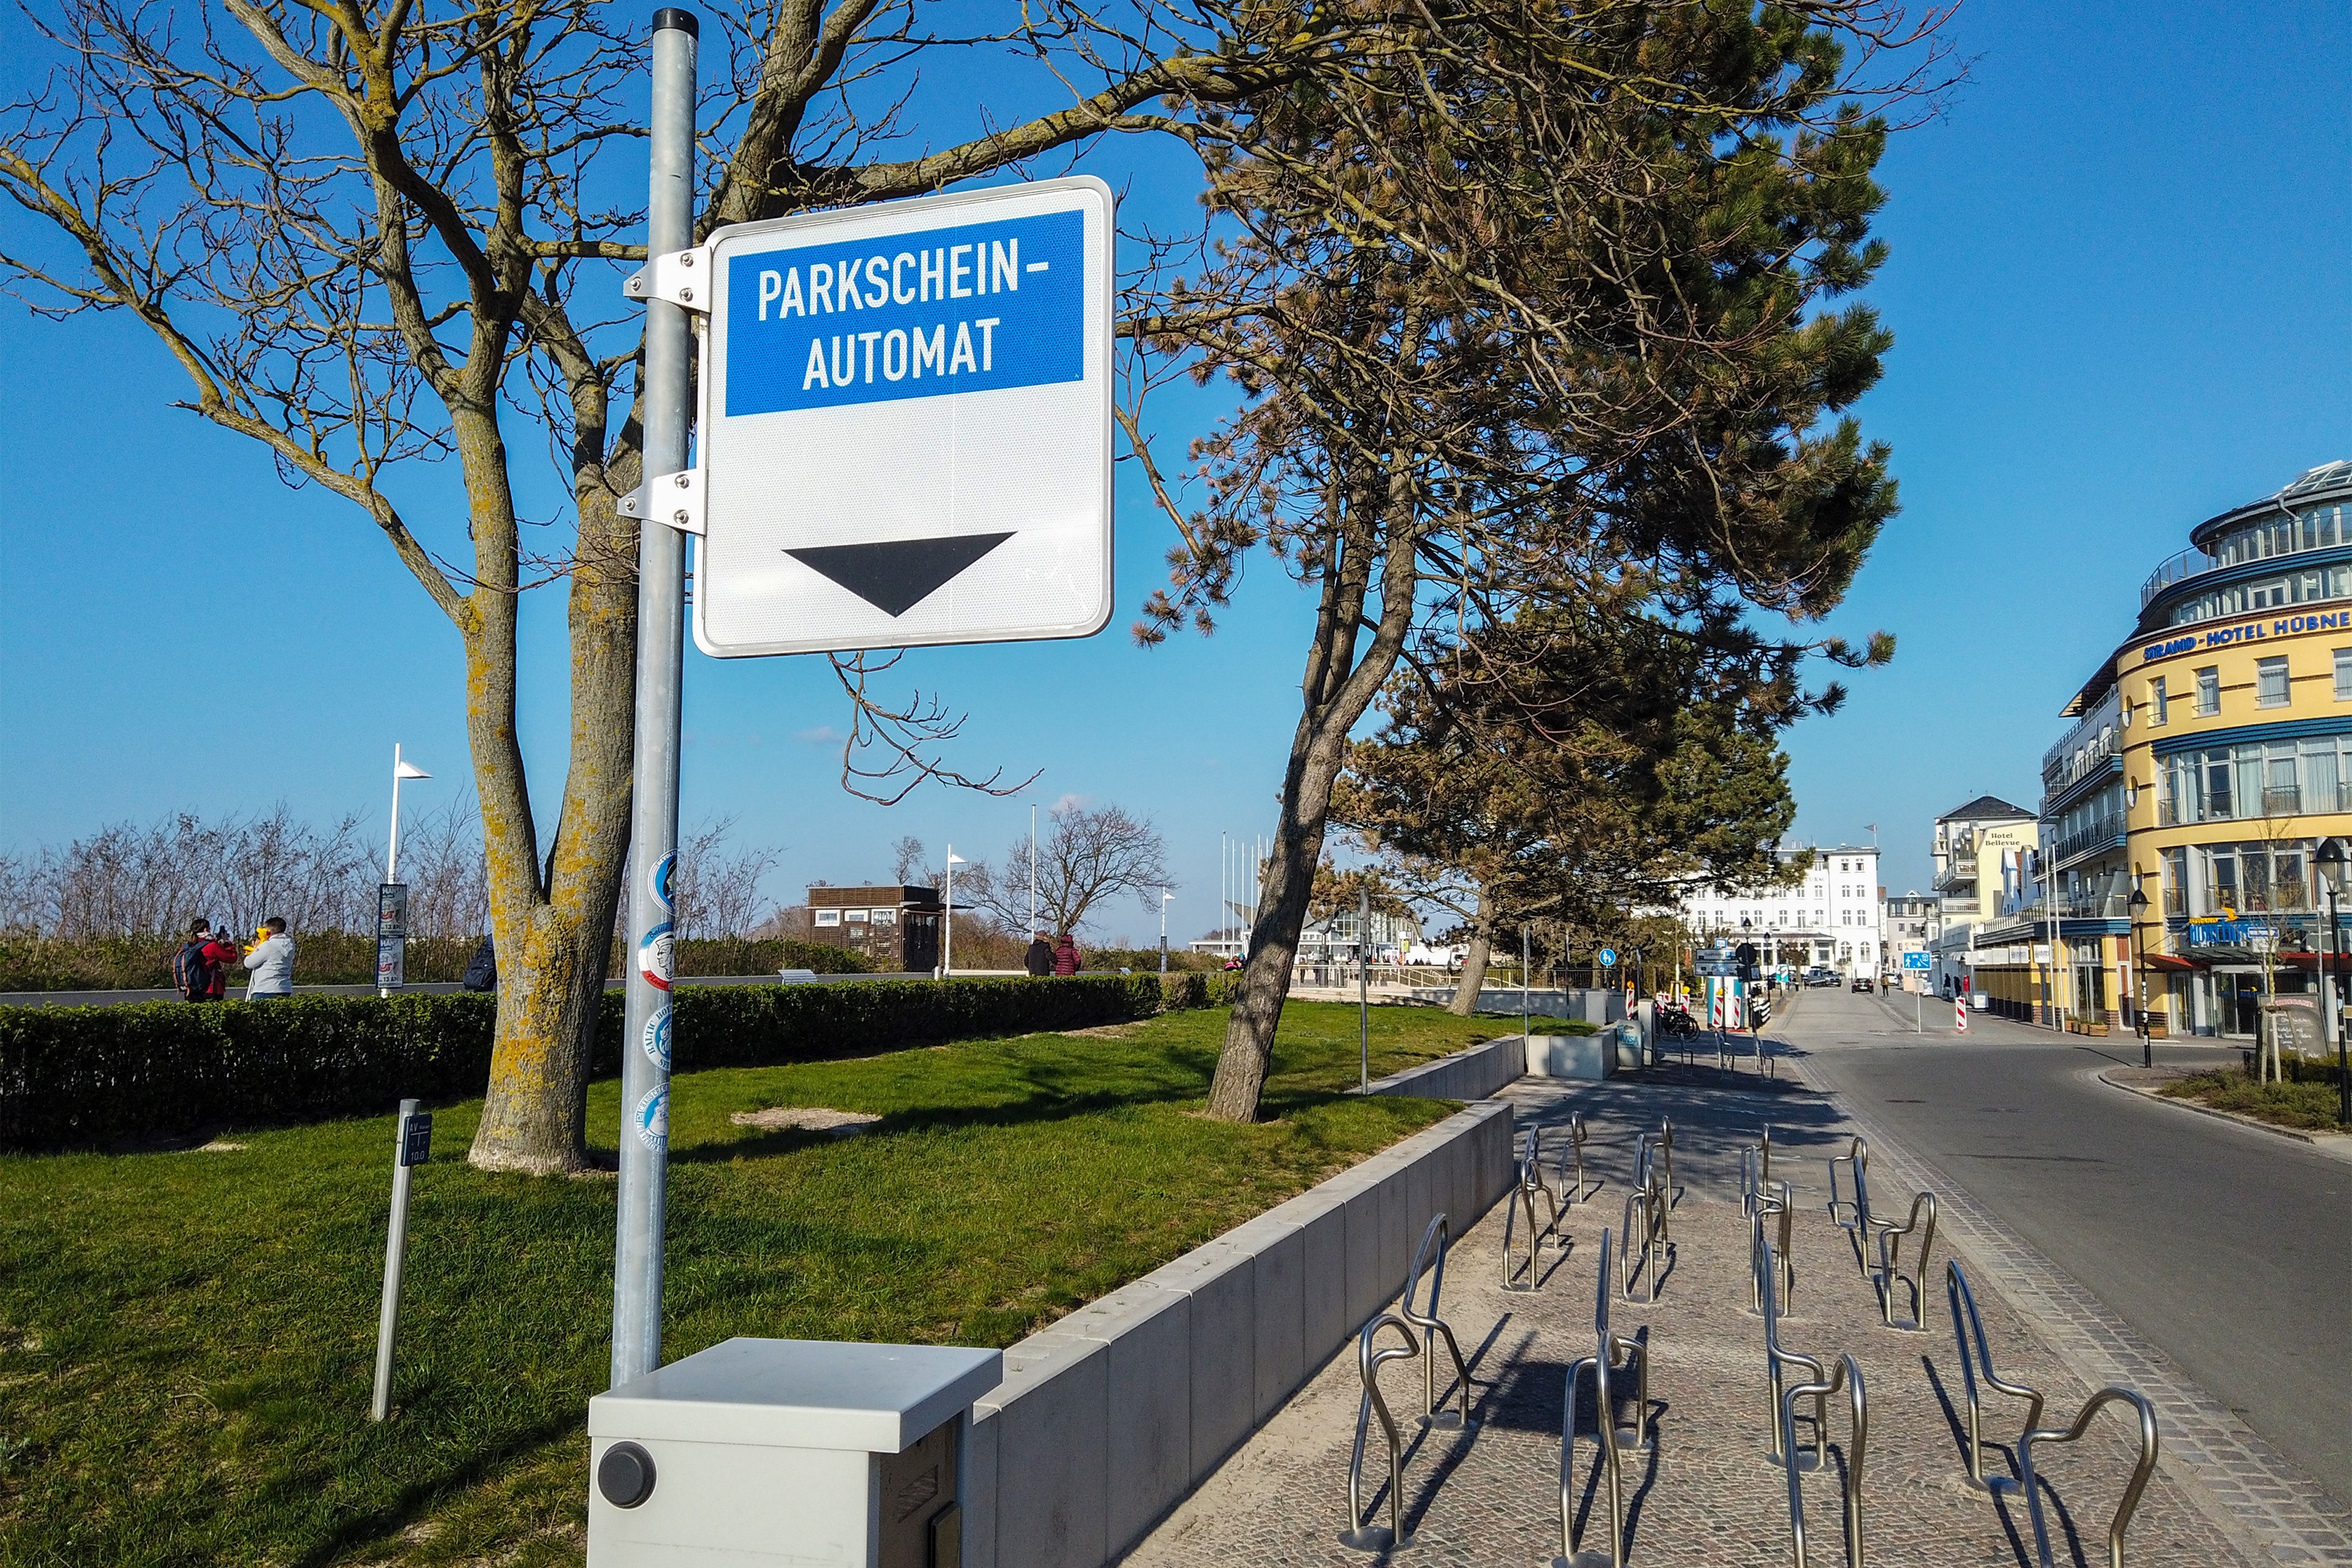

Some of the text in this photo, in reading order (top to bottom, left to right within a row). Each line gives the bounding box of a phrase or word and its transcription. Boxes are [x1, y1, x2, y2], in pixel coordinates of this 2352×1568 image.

[758, 238, 1049, 321] PARKSCHEIN-
[802, 318, 1000, 390] AUTOMAT
[644, 1020, 656, 1055] BALTIC
